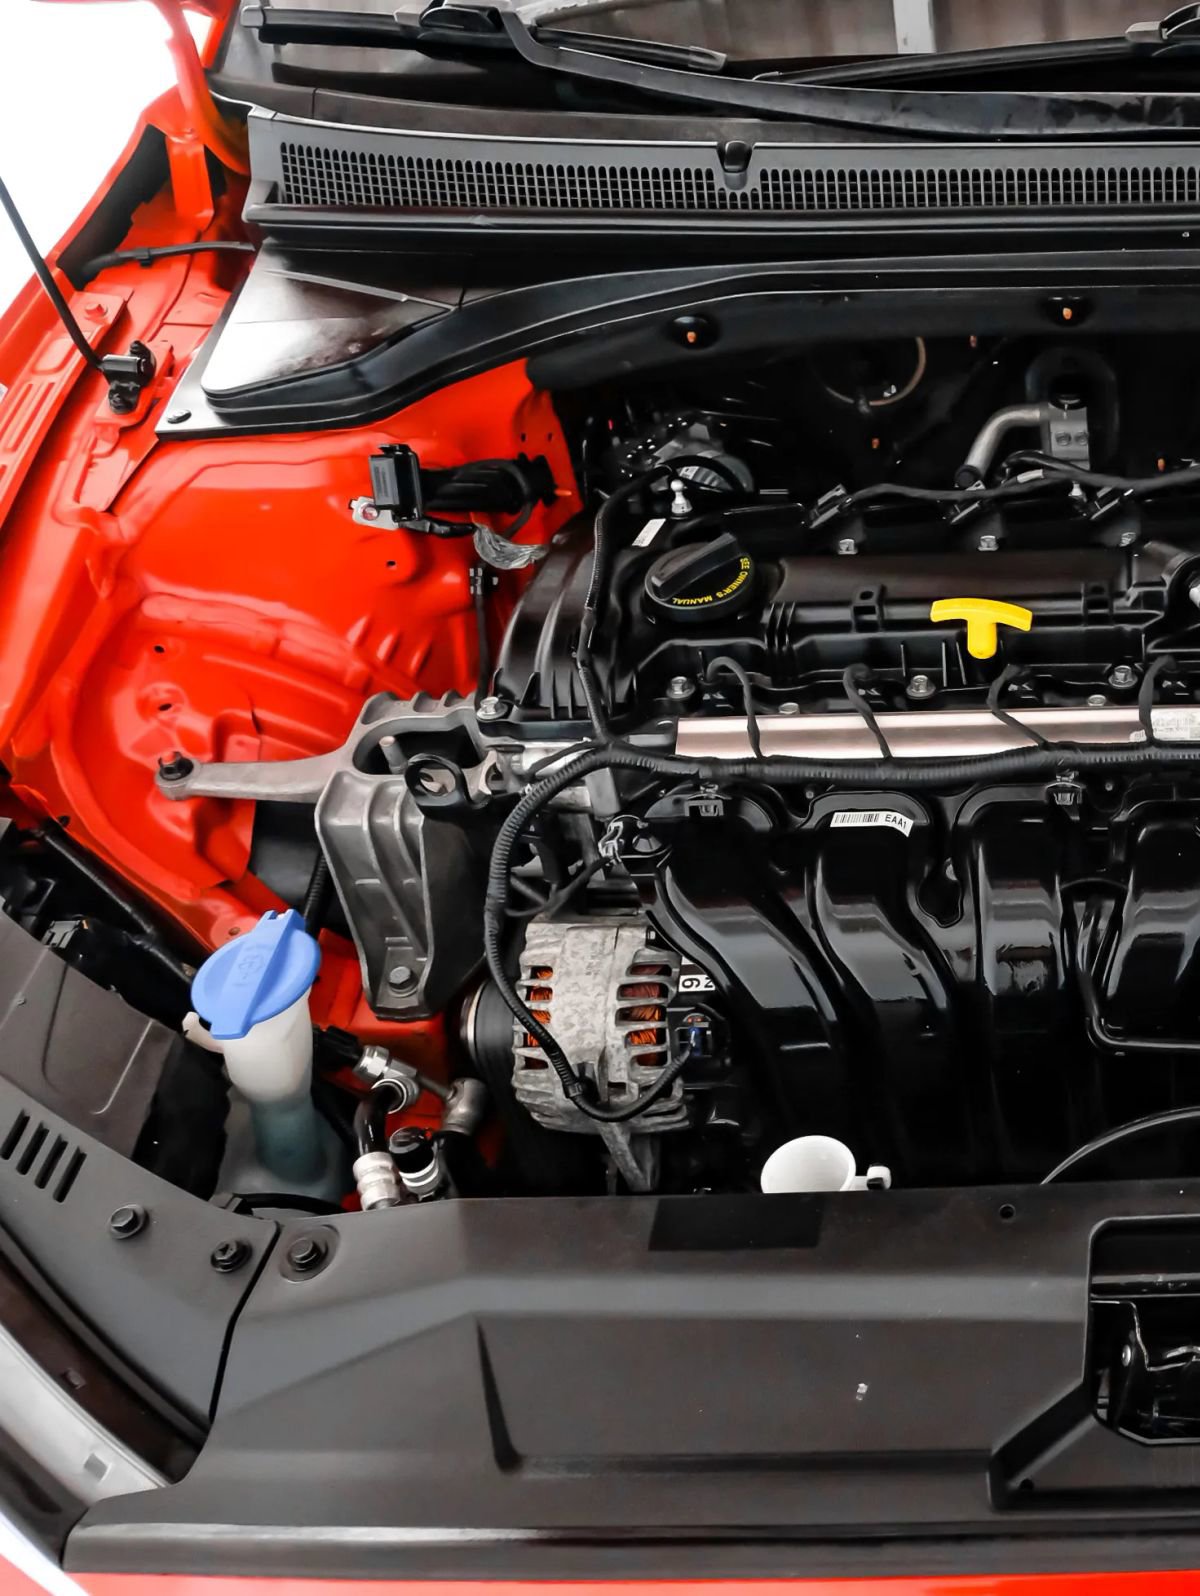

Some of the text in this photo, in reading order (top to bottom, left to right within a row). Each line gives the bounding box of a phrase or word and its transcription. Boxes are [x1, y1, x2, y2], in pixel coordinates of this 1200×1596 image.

[672, 558, 750, 605] SEE OWNER'S MANUAL
[884, 814, 907, 829] EAA1
